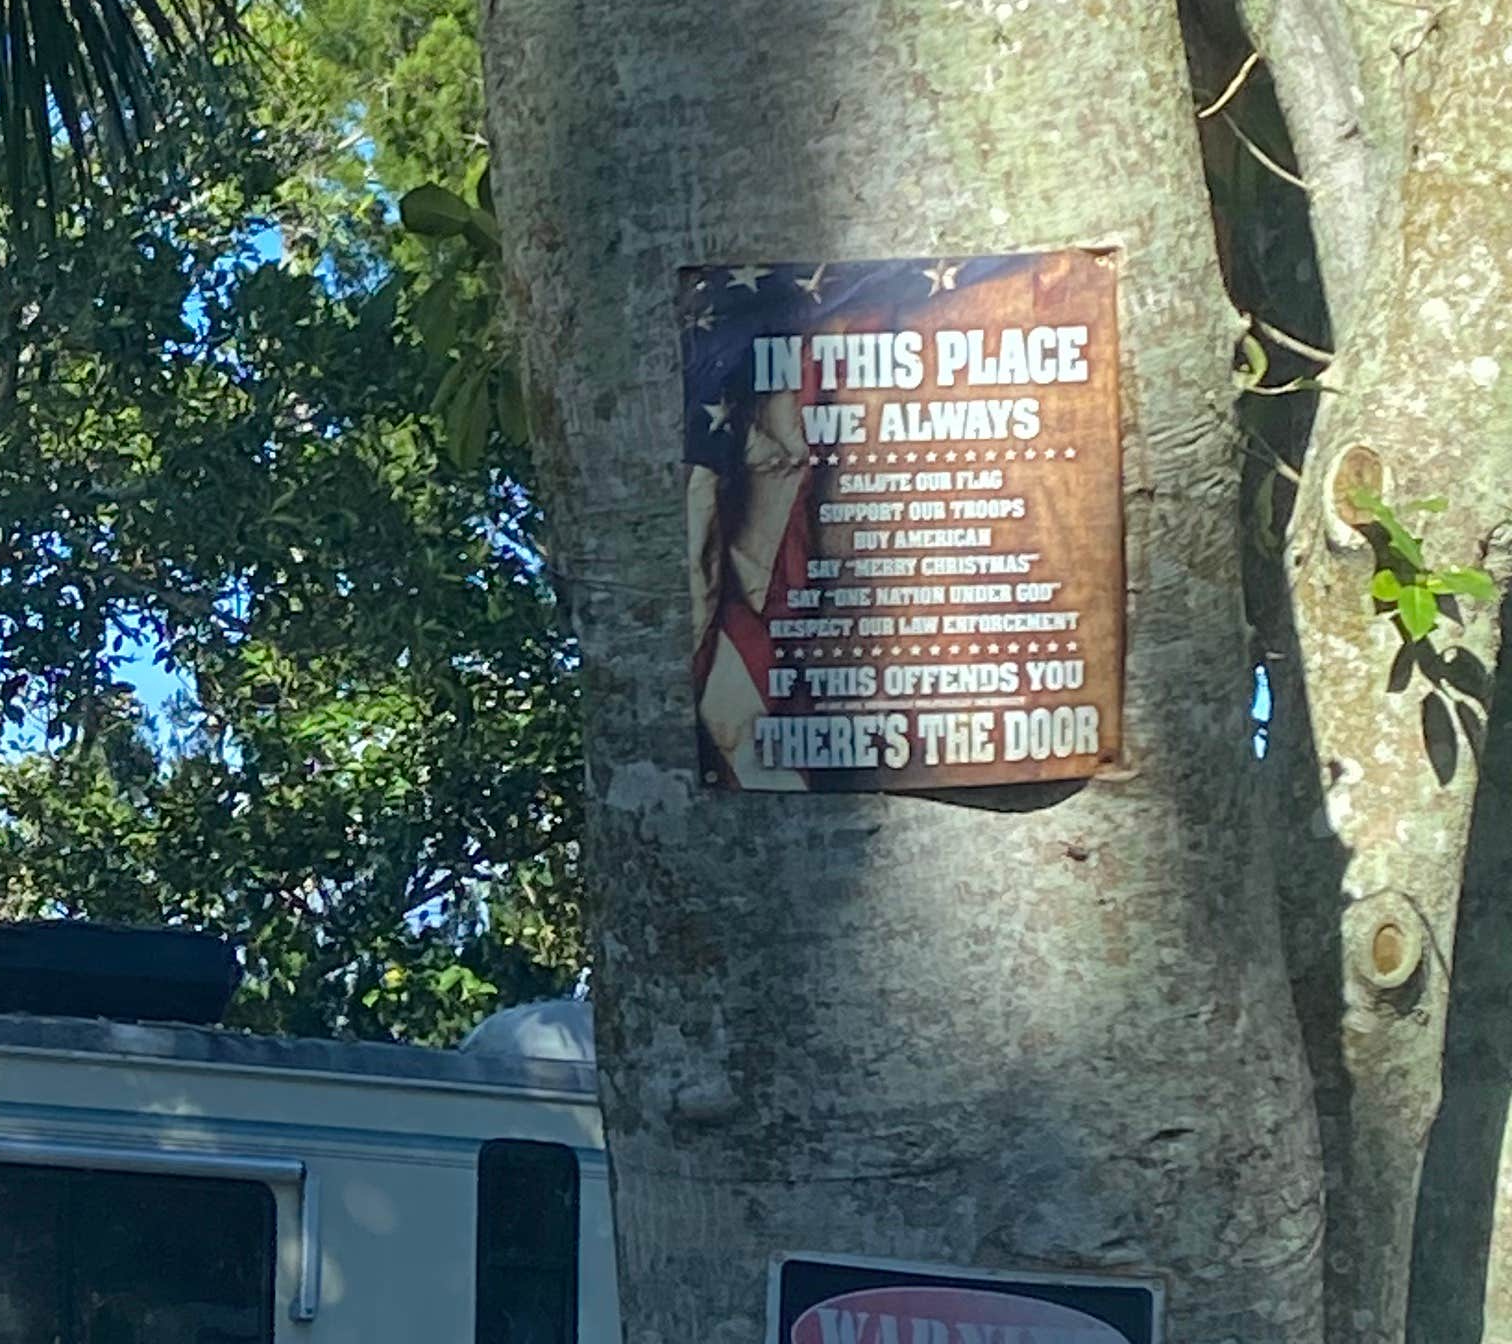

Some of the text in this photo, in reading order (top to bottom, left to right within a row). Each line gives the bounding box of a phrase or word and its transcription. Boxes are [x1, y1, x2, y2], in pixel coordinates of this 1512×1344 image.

[753, 326, 1088, 392] IN THIS PLACE
[802, 398, 1040, 444] WE ALWAYS
[840, 469, 1003, 493] SALUTE OUR FLAG
[819, 498, 1025, 522] SUPPORT OUR TROOPS
[853, 528, 992, 550] BUY AMERICAN
[807, 559, 840, 578] SAY
[788, 589, 822, 607] SAY
[875, 585, 945, 605] NATION
[949, 584, 1012, 604] UNDER
[769, 612, 1080, 638] RESPECT OUR LAW ENFORCEMENT
[768, 660, 1084, 697] IF THIS OFFENDS YOU
[755, 705, 1099, 769] THERE'S THE DOOR
